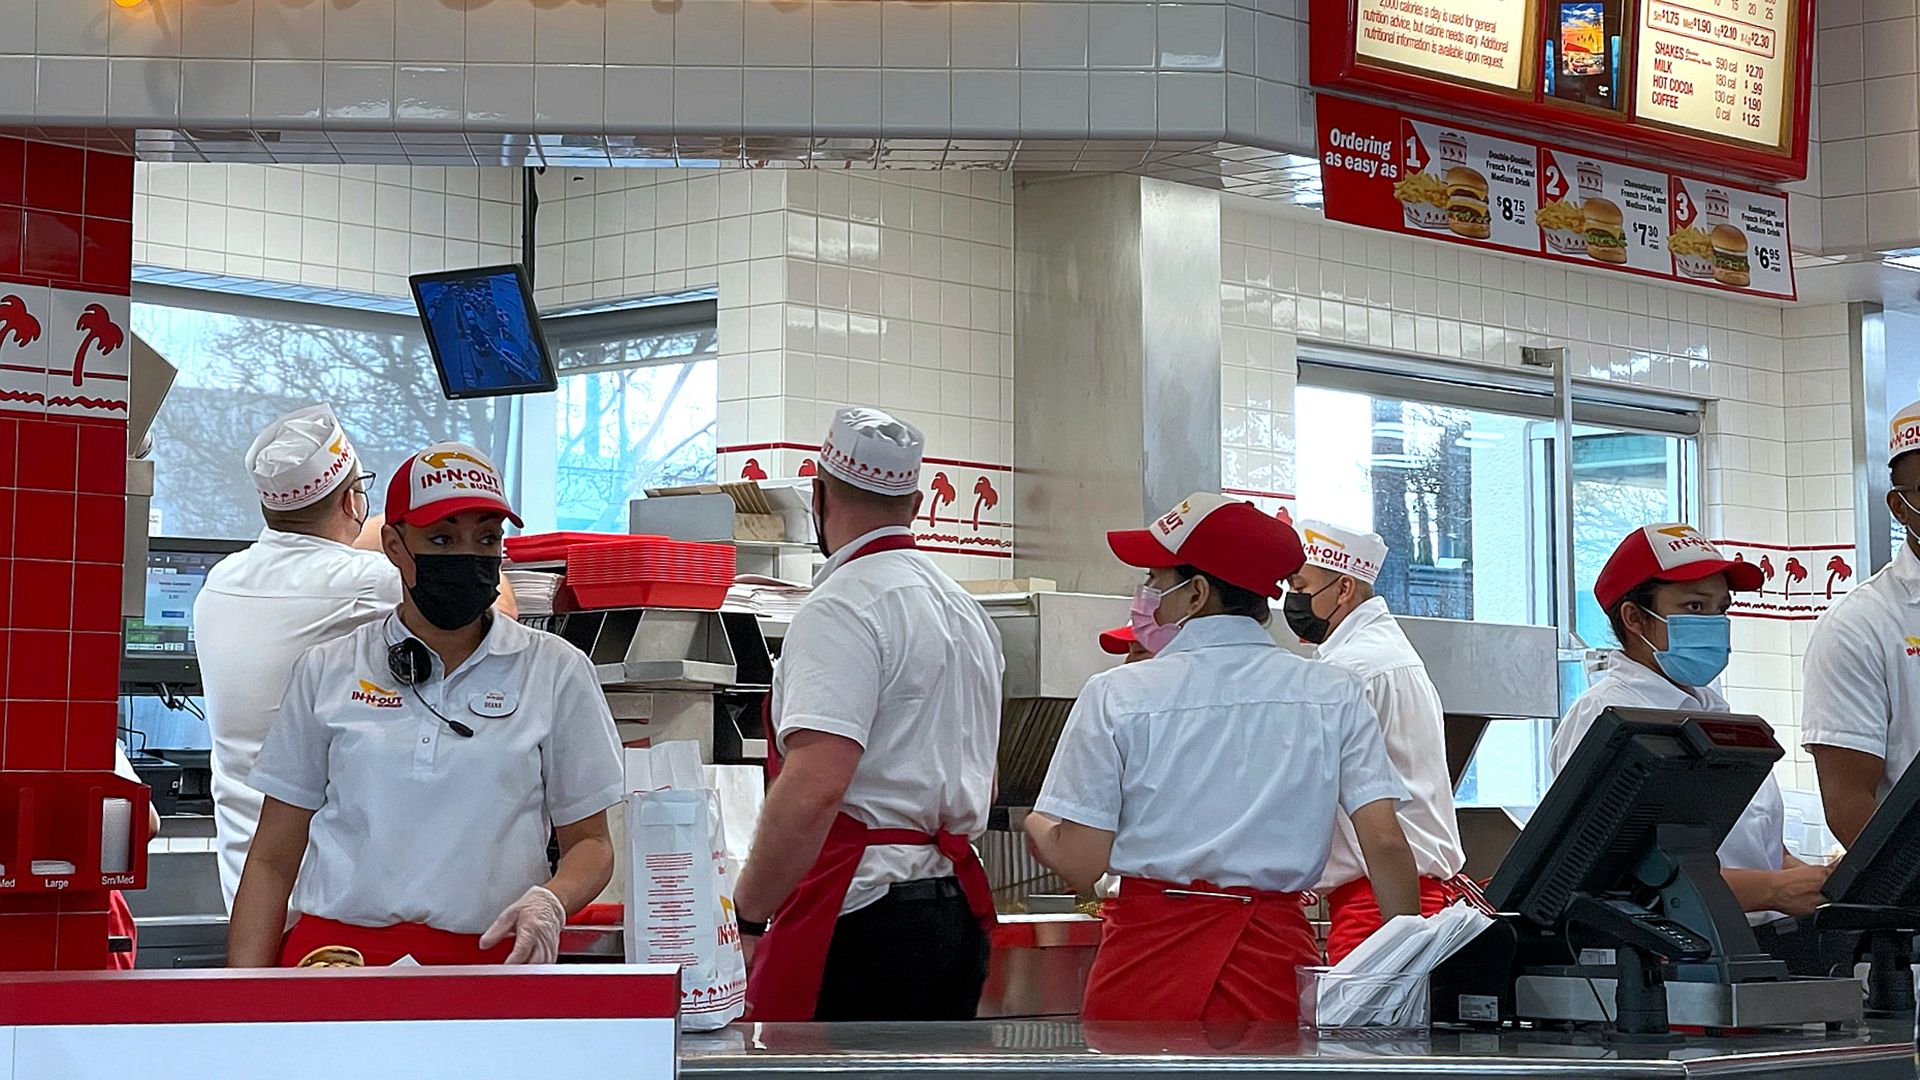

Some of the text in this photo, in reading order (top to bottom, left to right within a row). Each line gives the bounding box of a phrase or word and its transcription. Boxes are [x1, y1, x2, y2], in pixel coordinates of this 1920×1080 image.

[1400, 0, 1423, 16] calories
[1424, 7, 1429, 17] a
[1430, 5, 1441, 22] day
[1443, 8, 1448, 22] is
[1449, 13, 1464, 26] used
[1465, 14, 1474, 27] for
[1475, 18, 1497, 33] general
[1748, 3, 1757, 16] 20
[1765, 7, 1774, 20] 25
[1363, 9, 1389, 25] nutrition
[1390, 15, 1411, 32] advice,
[1413, 19, 1424, 33] but
[1425, 22, 1444, 38] calorie
[1446, 29, 1464, 43] needs
[1480, 35, 1509, 53] Additional
[1364, 27, 1504, 69] nutritional information is available upon request.
[1655, 41, 1684, 60] SHAKES
[1716, 57, 1728, 70] 590
[1729, 61, 1738, 73] cal
[1746, 64, 1763, 79] $2.70
[1654, 58, 1672, 74] MILK
[1716, 74, 1726, 86] 180
[1728, 78, 1736, 89] cal
[1653, 74, 1668, 89] HOT
[1669, 78, 1693, 96] COCOA
[1715, 90, 1725, 103] 130
[1727, 94, 1736, 106] cal
[1652, 91, 1679, 109] COFFEE
[1716, 106, 1721, 119] 0
[1722, 109, 1731, 121] cal
[1330, 128, 1392, 161] Ordering
[1406, 136, 1422, 168] 1
[1325, 151, 1398, 179] as easy as
[1486, 160, 1536, 178] French Fries, and
[1491, 172, 1530, 187] Medium Drink
[1546, 165, 1560, 196] 2
[1624, 179, 1662, 195] Cheeseburger,
[1621, 189, 1639, 199] French
[1641, 193, 1655, 203] Fries,
[1626, 200, 1662, 214] Medium Drink
[1675, 192, 1690, 221] 3
[1742, 213, 1758, 223] French
[1746, 224, 1780, 237] Medium Drink
[45, 879, 69, 890] Large
[101, 875, 135, 885] Sm/Med
